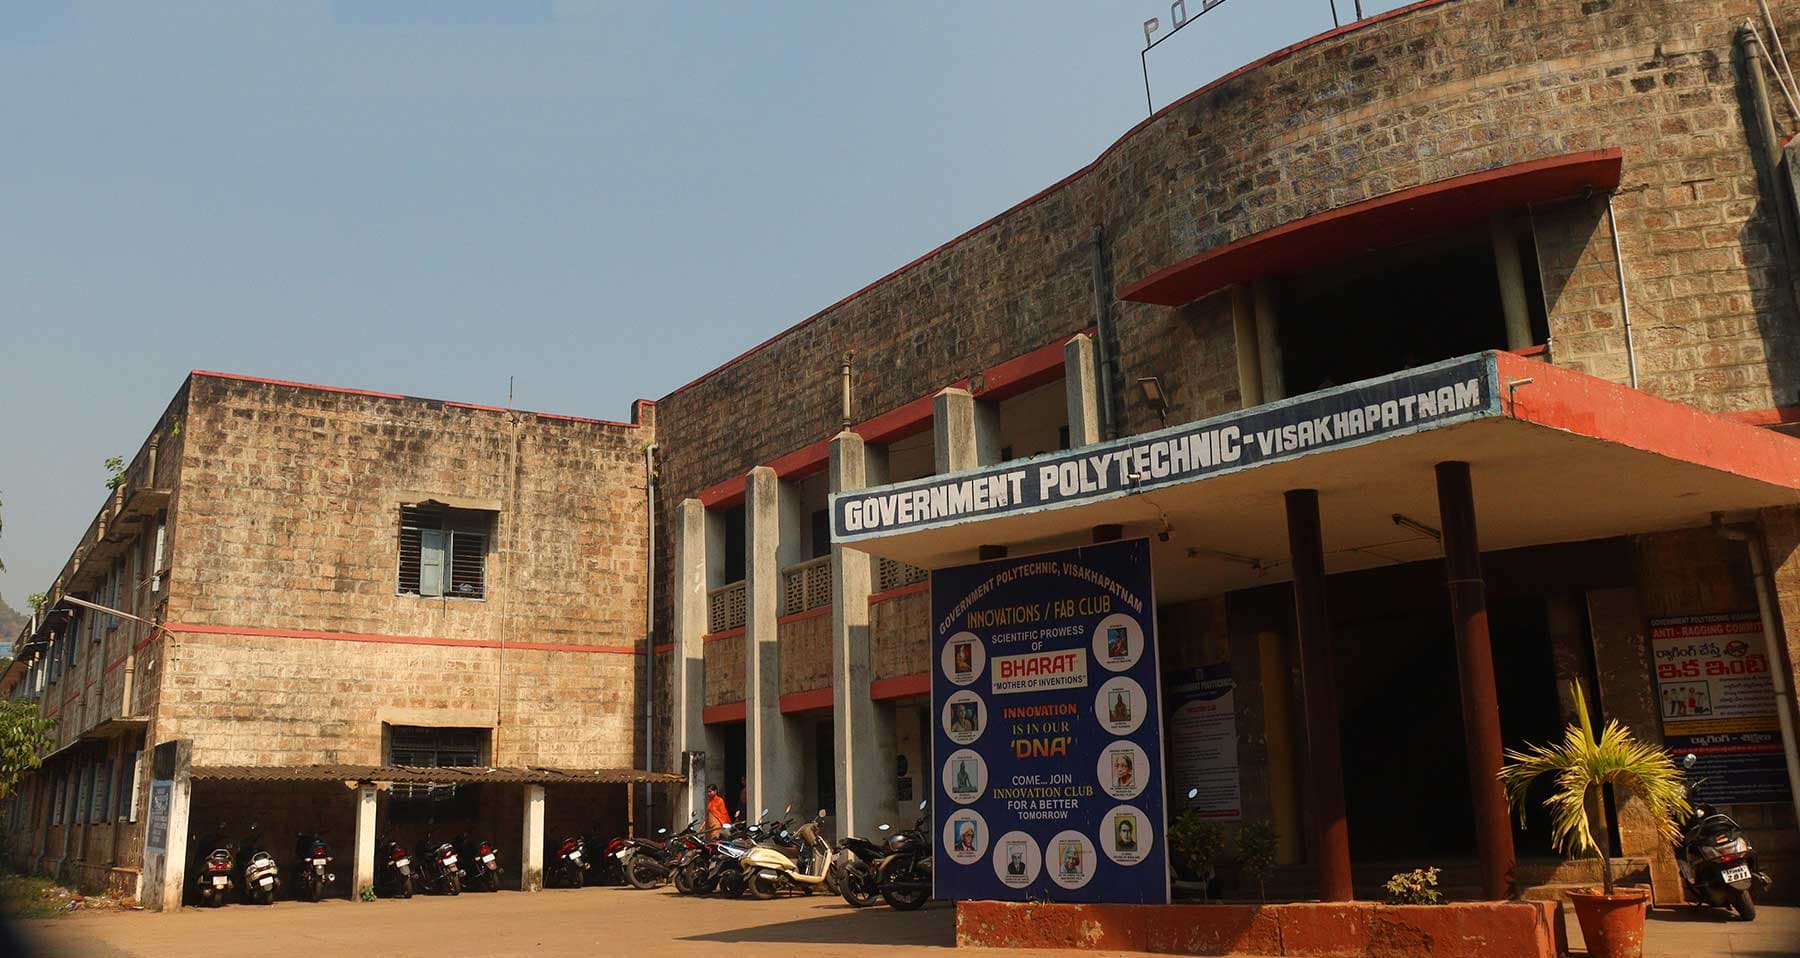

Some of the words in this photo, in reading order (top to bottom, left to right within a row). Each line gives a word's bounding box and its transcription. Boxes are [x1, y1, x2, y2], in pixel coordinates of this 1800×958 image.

[844, 470, 1026, 532] GOVERNMENT
[939, 578, 994, 635] GOVERNMENT
[996, 561, 1061, 587] POLYTECHNIC,
[1063, 562, 1144, 614] VISAKHAPATNAM
[967, 603, 1041, 629] INNOVATIONS
[1044, 602, 1050, 621] /
[1054, 599, 1074, 618] FAB
[1079, 595, 1111, 615] CLUB
[991, 630, 1039, 644] SCIENTIFIC
[1040, 625, 1084, 639] PROWESS
[1031, 641, 1044, 651] OF
[1000, 653, 1078, 678] BHARAT
[1028, 679, 1038, 688] OF
[1003, 703, 1078, 719] INNOVATION
[1012, 723, 1023, 735] IS
[1026, 722, 1040, 735] IN
[1042, 720, 1070, 733] OUR
[1049, 774, 1073, 784] JOIN
[992, 786, 1060, 799] INNOVATION
[1064, 785, 1093, 797] CLUB
[1007, 800, 1027, 810] FOR
[1029, 800, 1037, 810] A
[1038, 799, 1079, 809] BETTER
[1018, 810, 1068, 820] TOMORROW
